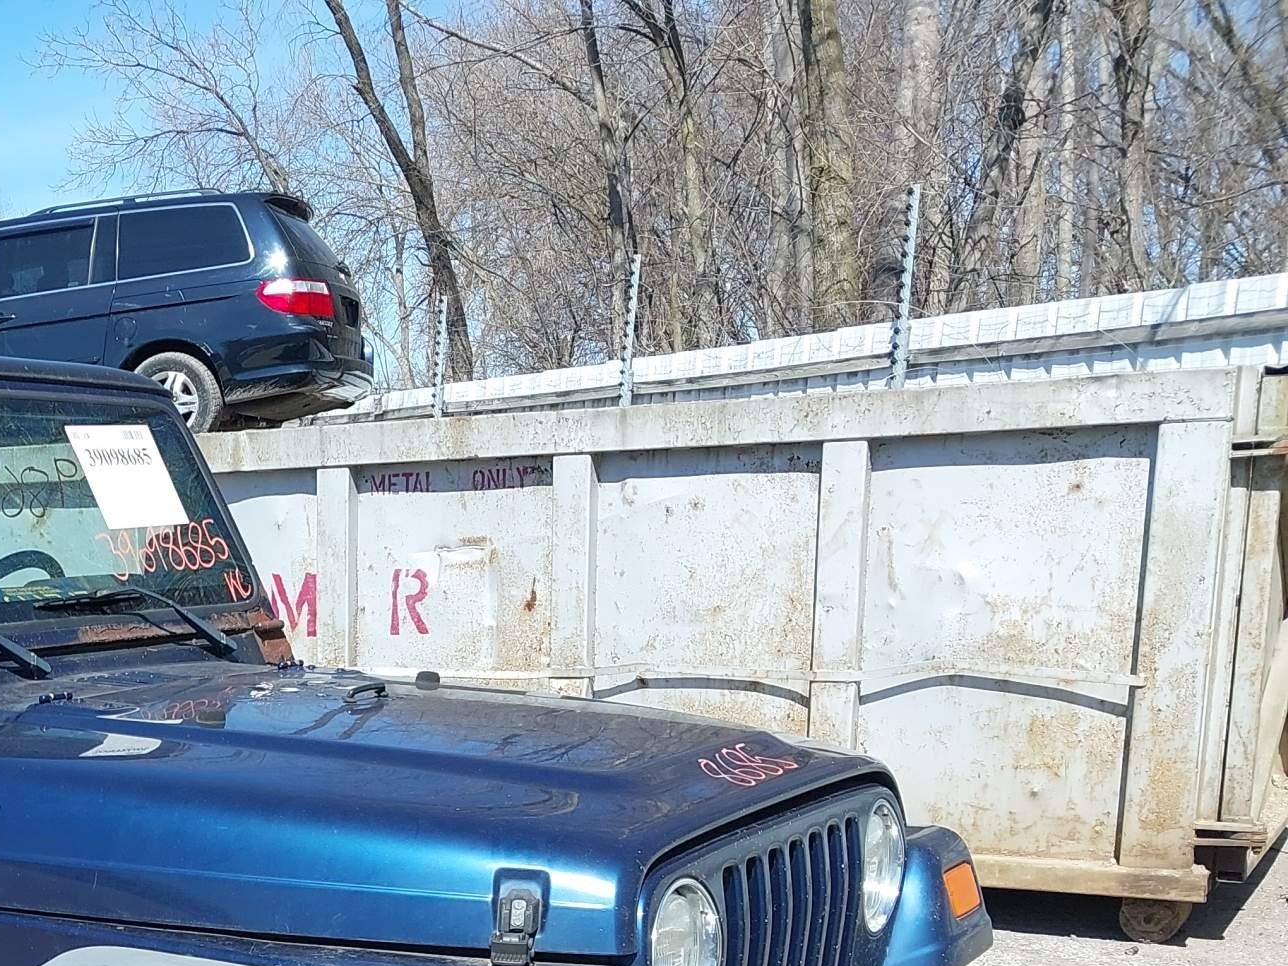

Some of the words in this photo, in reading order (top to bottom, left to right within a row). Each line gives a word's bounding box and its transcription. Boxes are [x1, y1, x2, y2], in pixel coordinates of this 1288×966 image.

[84, 448, 152, 467] 39098685
[472, 465, 527, 491] ONLY
[390, 568, 430, 635] R
[698, 743, 799, 786] 8685
